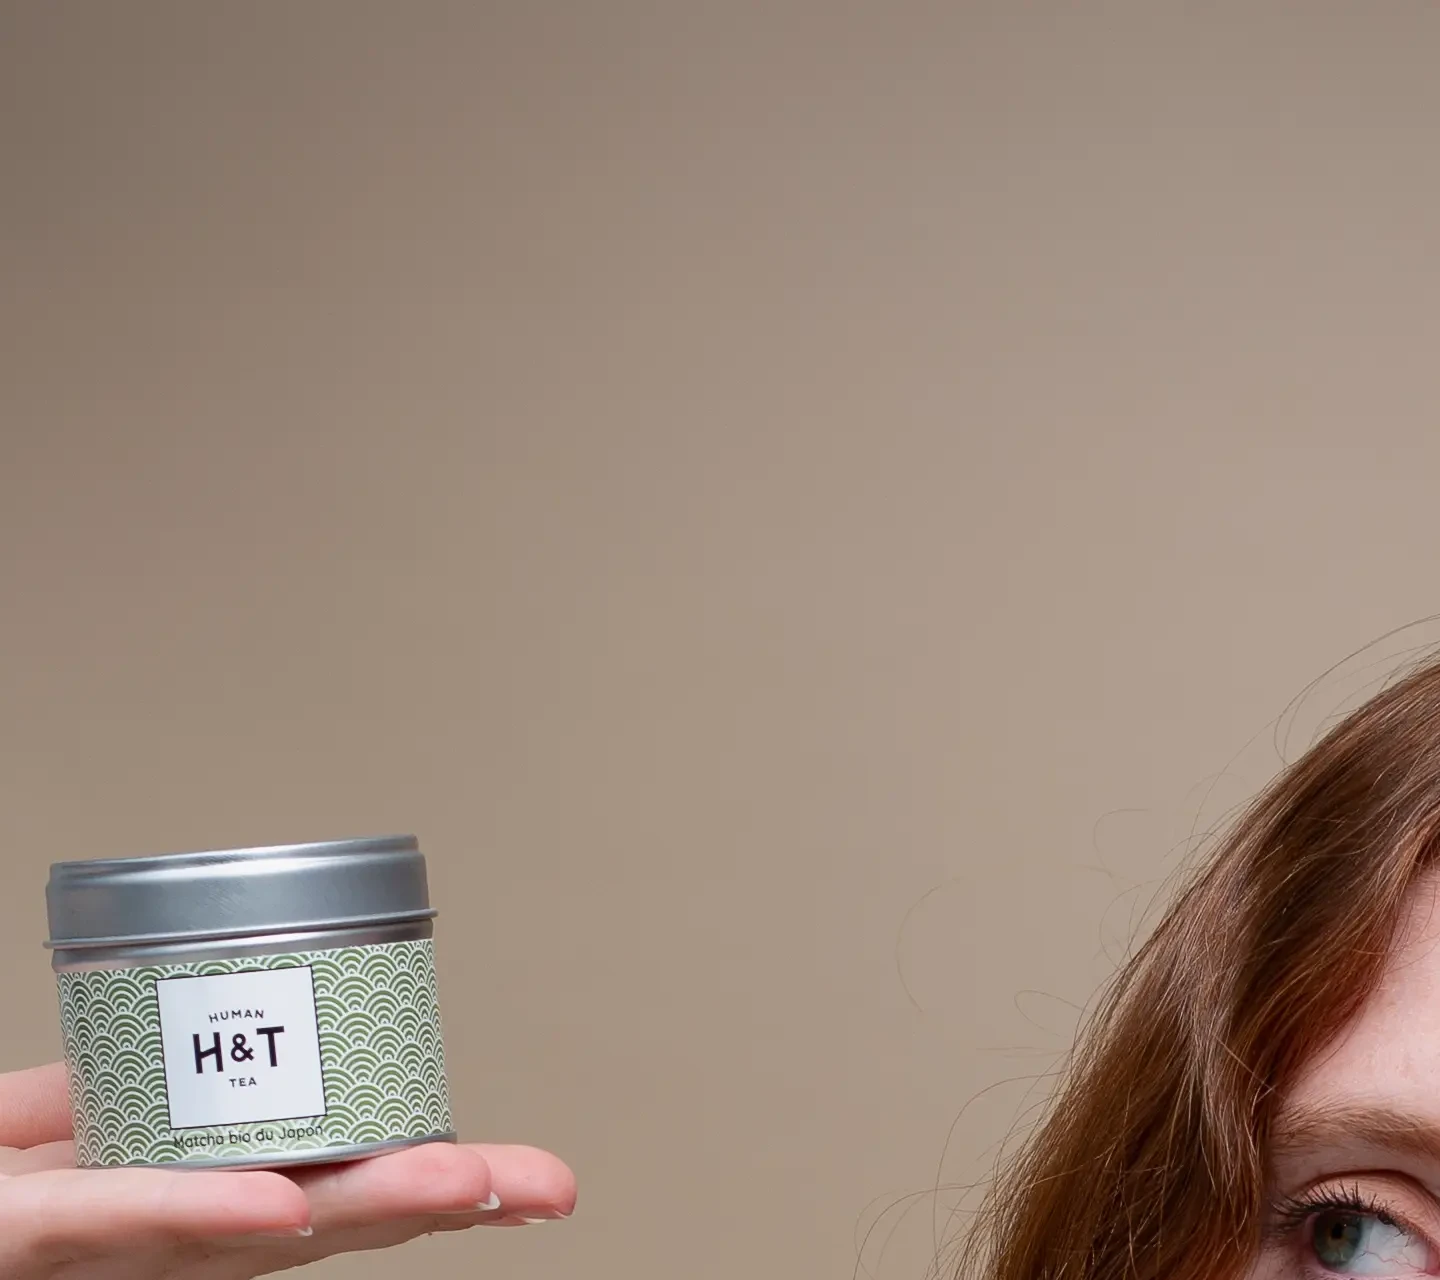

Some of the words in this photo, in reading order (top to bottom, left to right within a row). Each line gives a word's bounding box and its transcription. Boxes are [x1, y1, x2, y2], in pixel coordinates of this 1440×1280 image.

[208, 1009, 264, 1023] HUMAN
[192, 1025, 285, 1074] H&T
[228, 1077, 257, 1088] TEA
[173, 1132, 224, 1148] Matcha
[228, 1130, 251, 1145] bio
[255, 1128, 274, 1141] du
[279, 1125, 324, 1141] Japon
